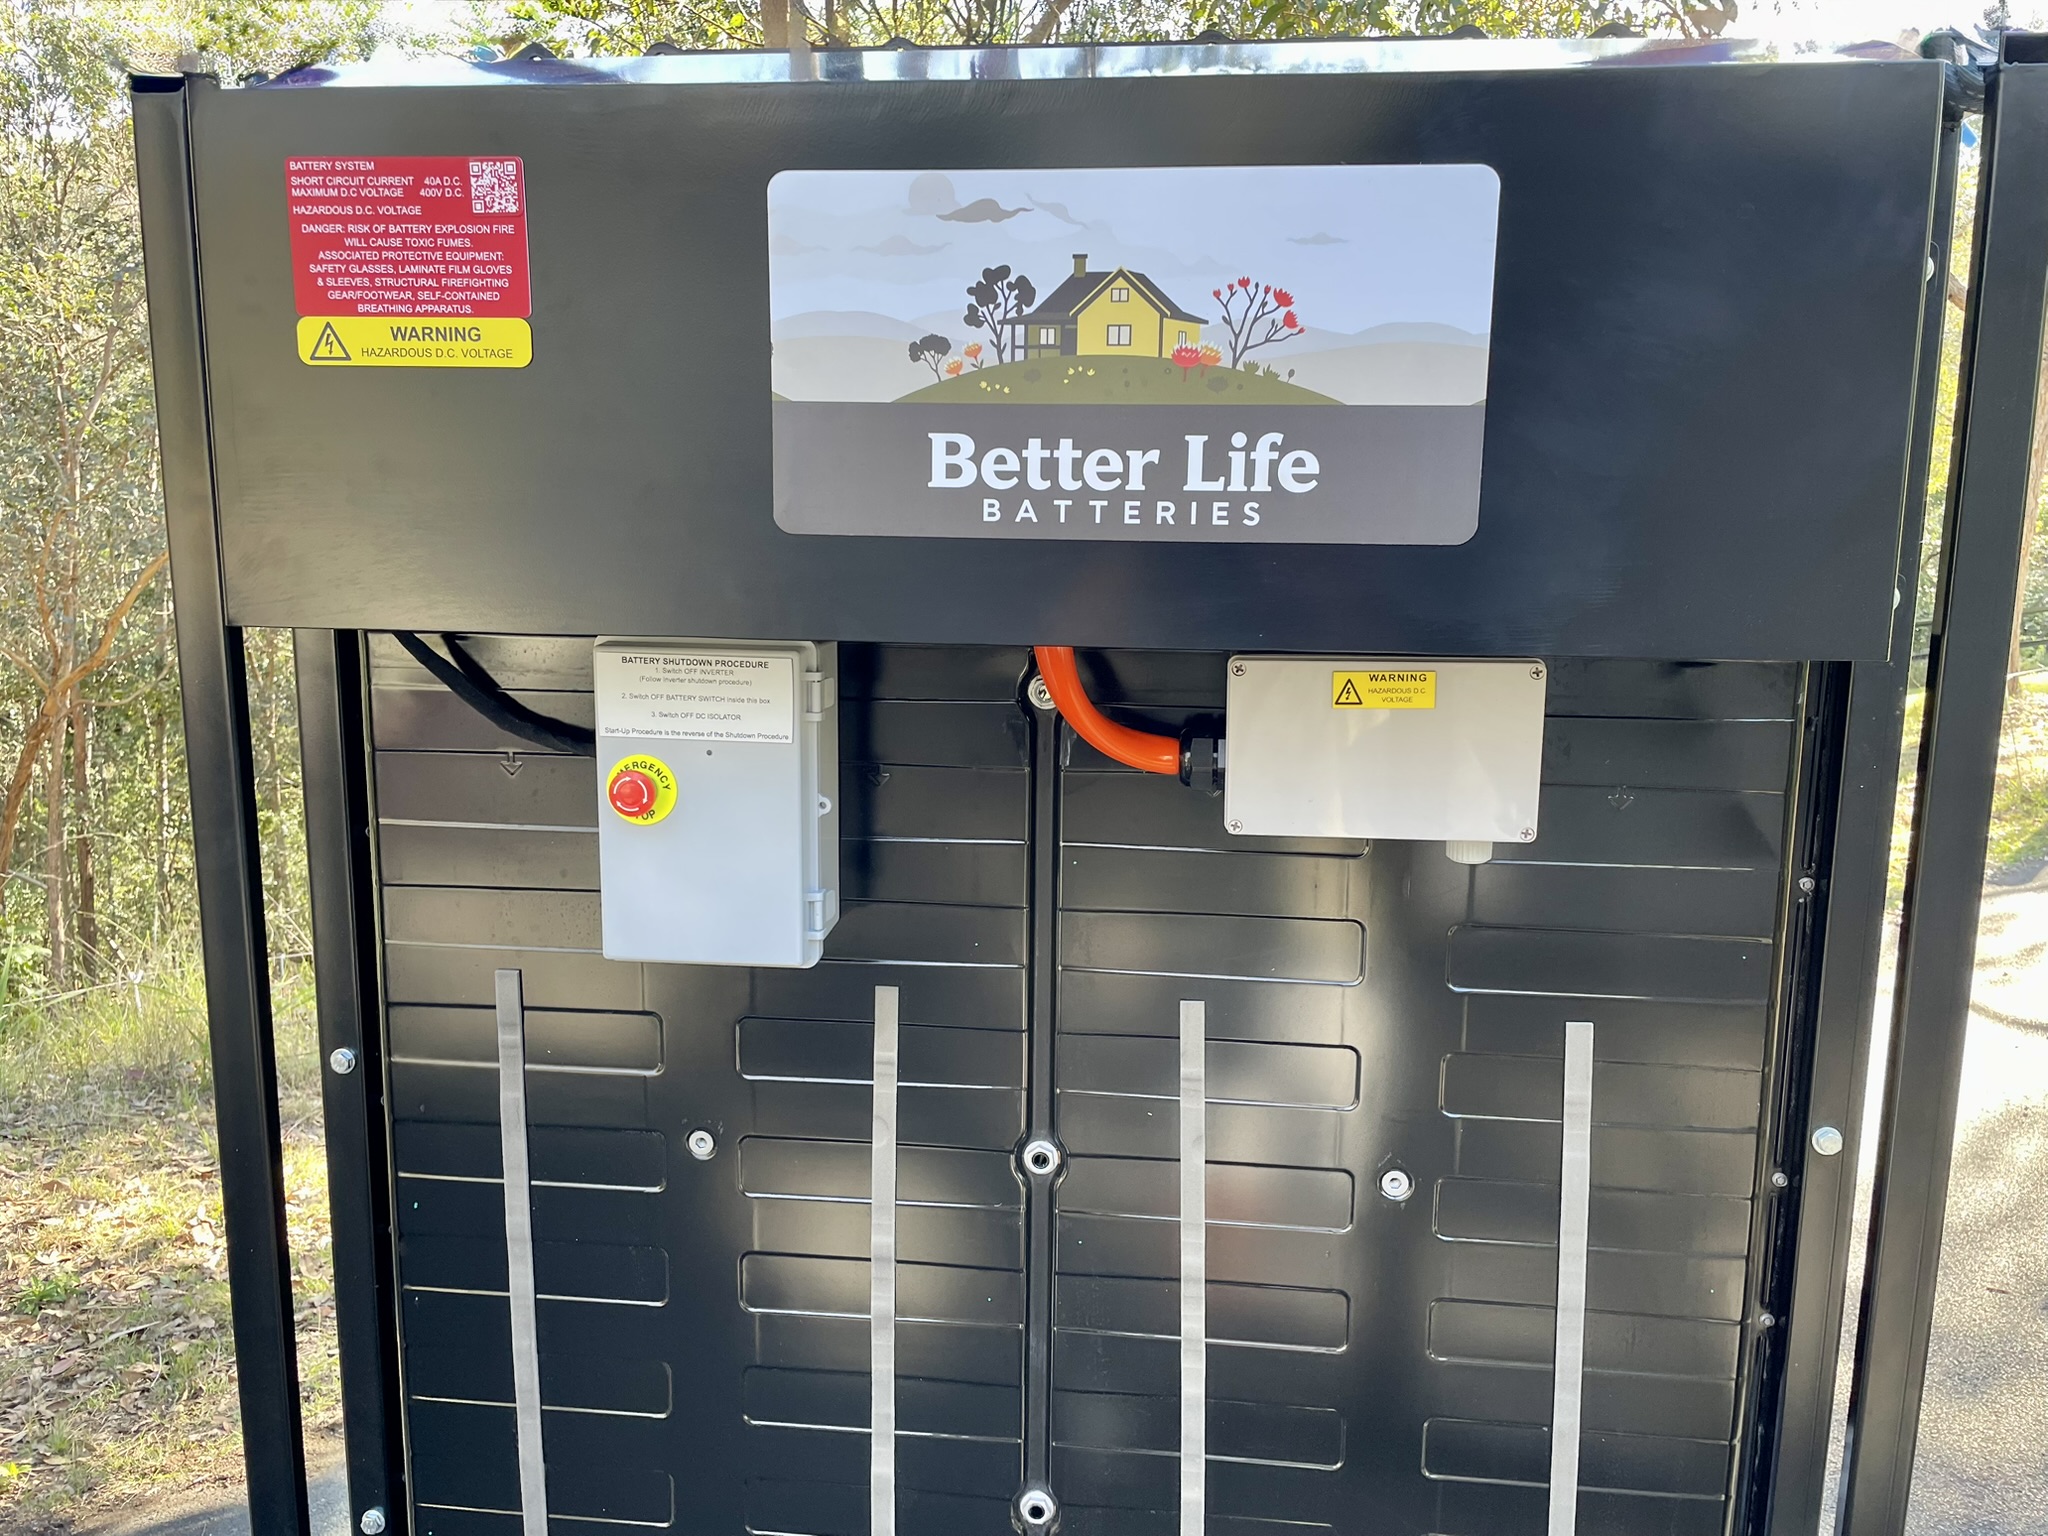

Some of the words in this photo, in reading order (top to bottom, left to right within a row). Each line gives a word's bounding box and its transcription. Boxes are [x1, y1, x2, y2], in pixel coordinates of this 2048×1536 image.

[290, 162, 333, 170] BATTERY
[335, 162, 374, 170] SYSTEM
[291, 177, 325, 185] SHORT
[327, 177, 365, 185] CIRCUIT
[367, 177, 414, 185] CURRENT
[424, 177, 442, 185] 40A
[444, 177, 462, 185] D.C.
[292, 188, 338, 197] MAXIMUM
[359, 188, 404, 197] VOLTAGE
[420, 189, 443, 197] 400V
[445, 189, 464, 197] D.C.
[293, 206, 353, 215] HAZARDOUS
[356, 206, 375, 215] D.C.
[377, 206, 422, 215] VOLTAGE
[302, 224, 345, 233] DANGER:
[348, 225, 370, 233] RISK
[373, 225, 386, 233] OF
[389, 225, 432, 233] BATTERY
[436, 225, 491, 234] EXPLOSION
[493, 225, 515, 234] FIRE
[344, 238, 367, 246] WILL
[370, 238, 403, 246] CAUSE
[405, 238, 435, 247] TOXIC
[437, 239, 473, 247] FUMES.
[319, 252, 380, 260] ASSOCIATED
[382, 252, 443, 260] PROTECTIVE
[446, 252, 504, 261] EQUIPMENT:
[310, 265, 347, 273] SAFETY
[349, 265, 396, 274] GLASSES,
[399, 265, 446, 274] LAMINATE
[449, 265, 470, 274] FILM
[473, 265, 512, 274] GLOVES
[317, 278, 323, 286] &
[326, 278, 372, 287] SLEEVES,
[375, 278, 439, 287] STRUCTURAL
[442, 279, 509, 287] FIREFIGHTING
[328, 291, 415, 301] GEAR/FOOTWEAR,
[418, 292, 500, 300] SELF-CONTAINED
[358, 304, 412, 313] BREATHING
[415, 305, 474, 313] APPARATUS.
[390, 326, 481, 341] WARNING
[361, 348, 432, 357] HAZARDOUS
[436, 349, 458, 358] D.C.
[461, 349, 512, 358] VOLTAGE
[927, 433, 1160, 491] Better
[1183, 432, 1320, 493] Life
[983, 499, 1261, 526] BATTERIES
[621, 657, 660, 665] BATTERY
[663, 658, 712, 667] SHUTDOWN
[715, 660, 769, 669] PROCEDURE
[1369, 674, 1427, 682] WARNING
[605, 727, 630, 735] Start-Up
[632, 728, 663, 736] Procedure
